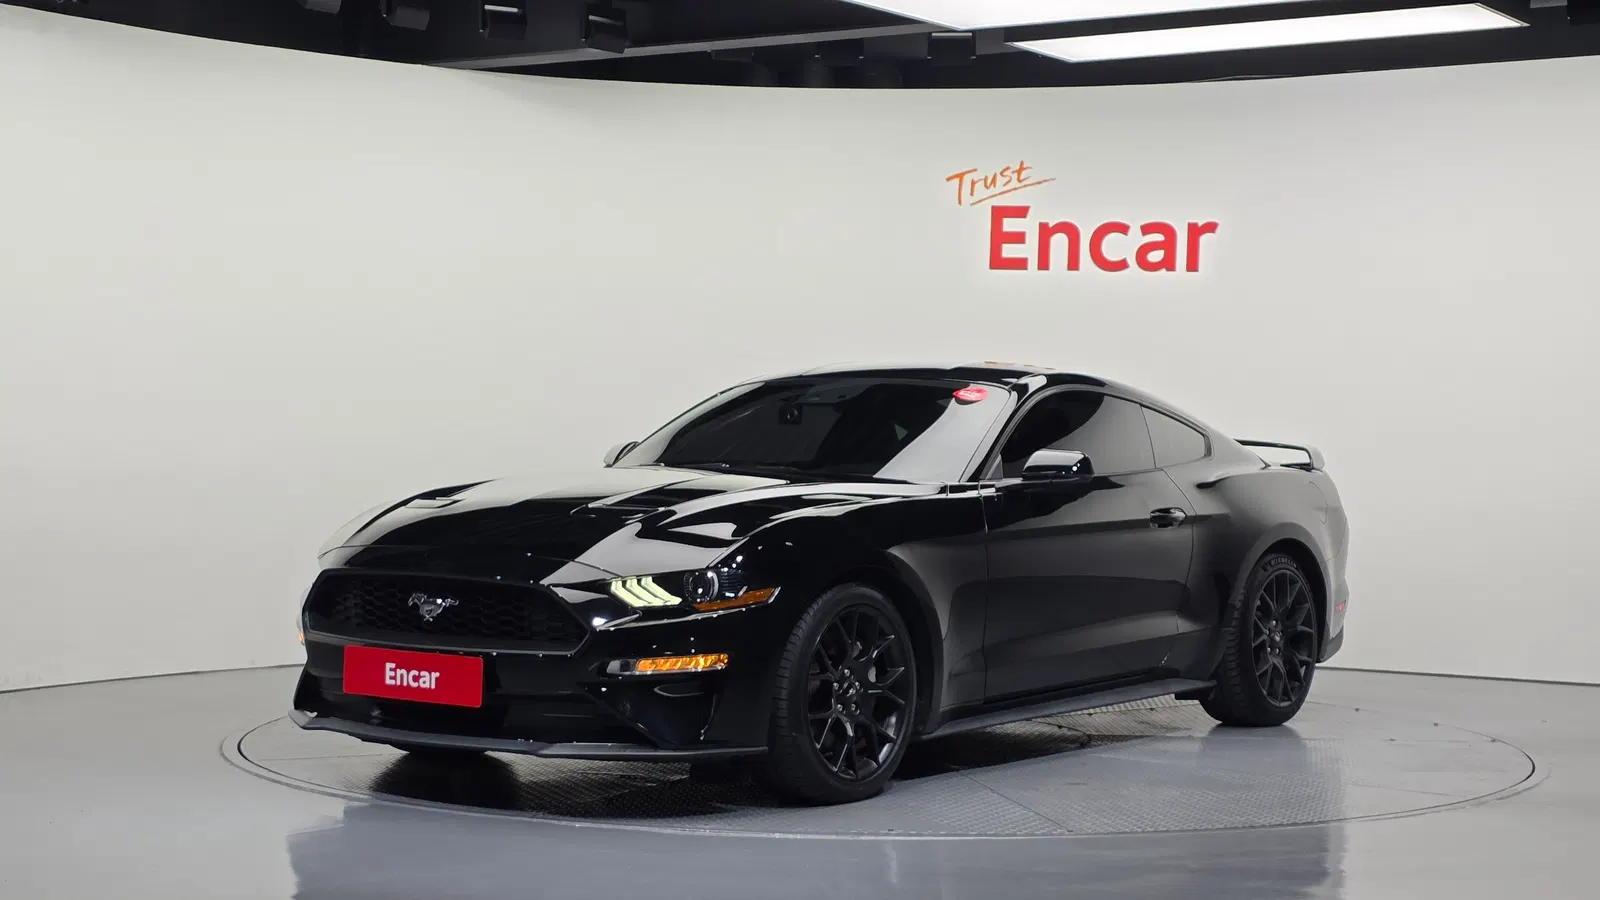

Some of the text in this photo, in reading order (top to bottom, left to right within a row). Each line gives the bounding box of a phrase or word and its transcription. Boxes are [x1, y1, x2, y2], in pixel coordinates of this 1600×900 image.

[945, 160, 1034, 206] Trust
[989, 205, 1220, 272] Encar
[384, 662, 440, 689] Encar
